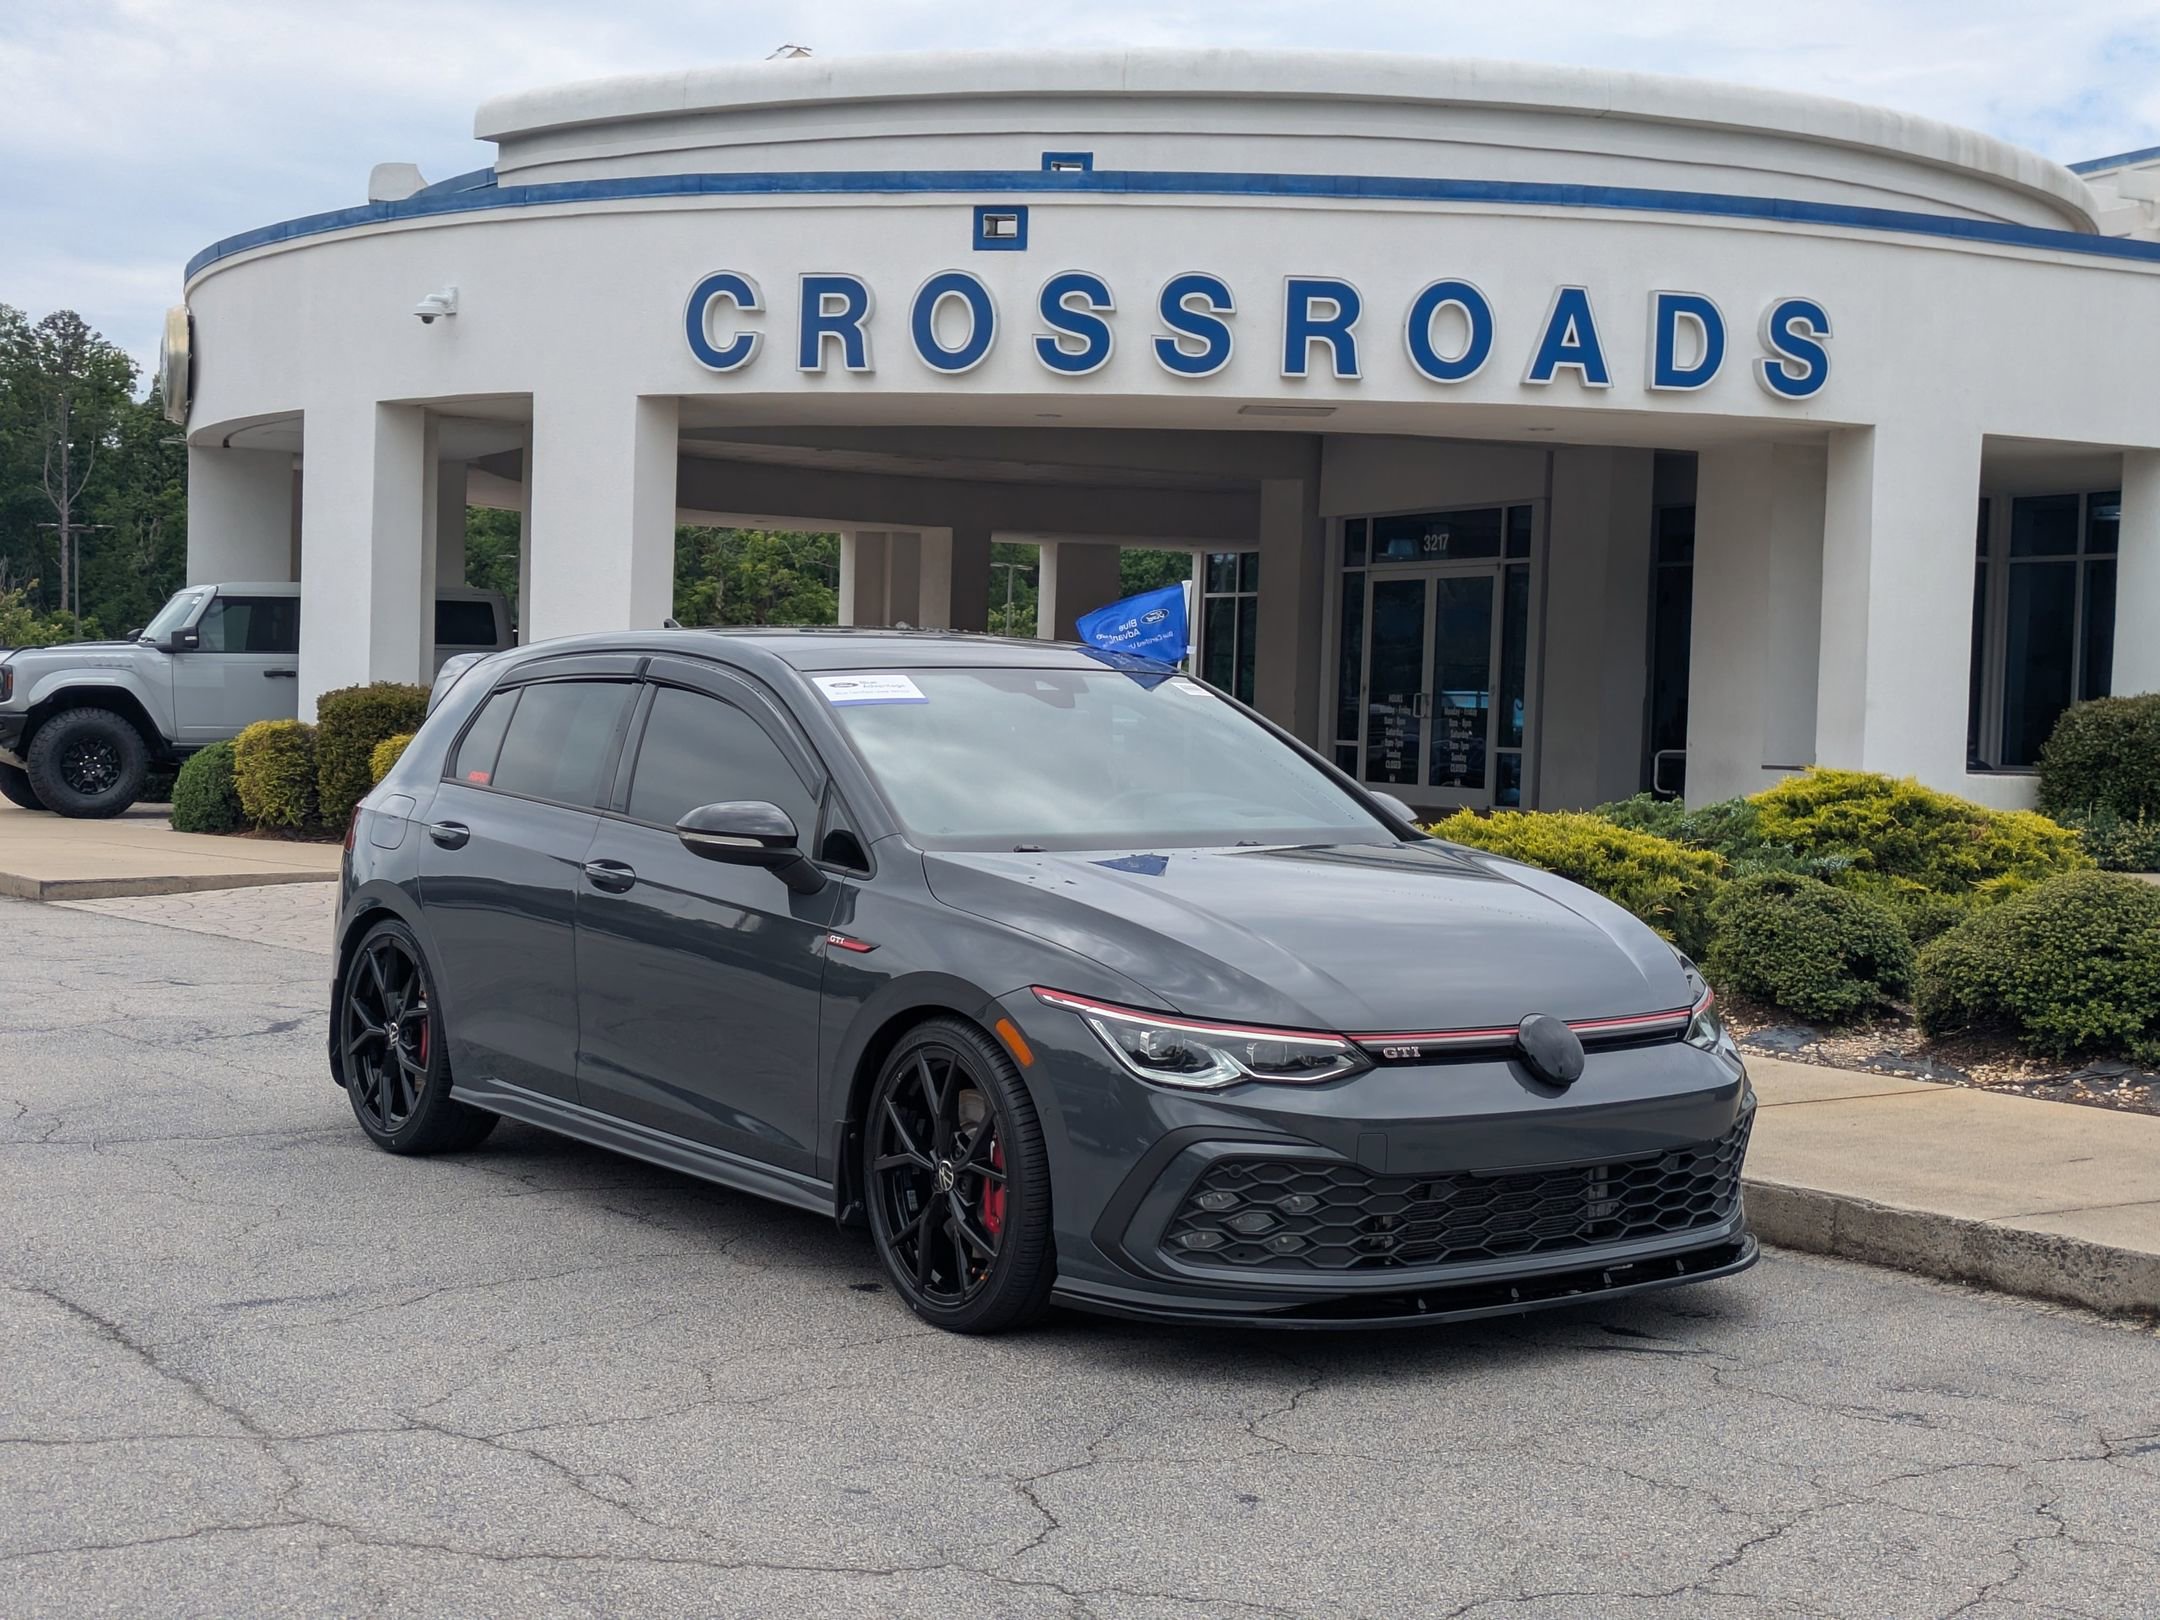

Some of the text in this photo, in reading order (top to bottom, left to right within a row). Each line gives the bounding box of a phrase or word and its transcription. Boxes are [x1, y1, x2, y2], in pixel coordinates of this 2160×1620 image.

[684, 269, 1834, 400] CROSSROADS
[1423, 533, 1449, 551] 3217
[830, 935, 845, 944] GTI
[1383, 1046, 1421, 1059] GTI
